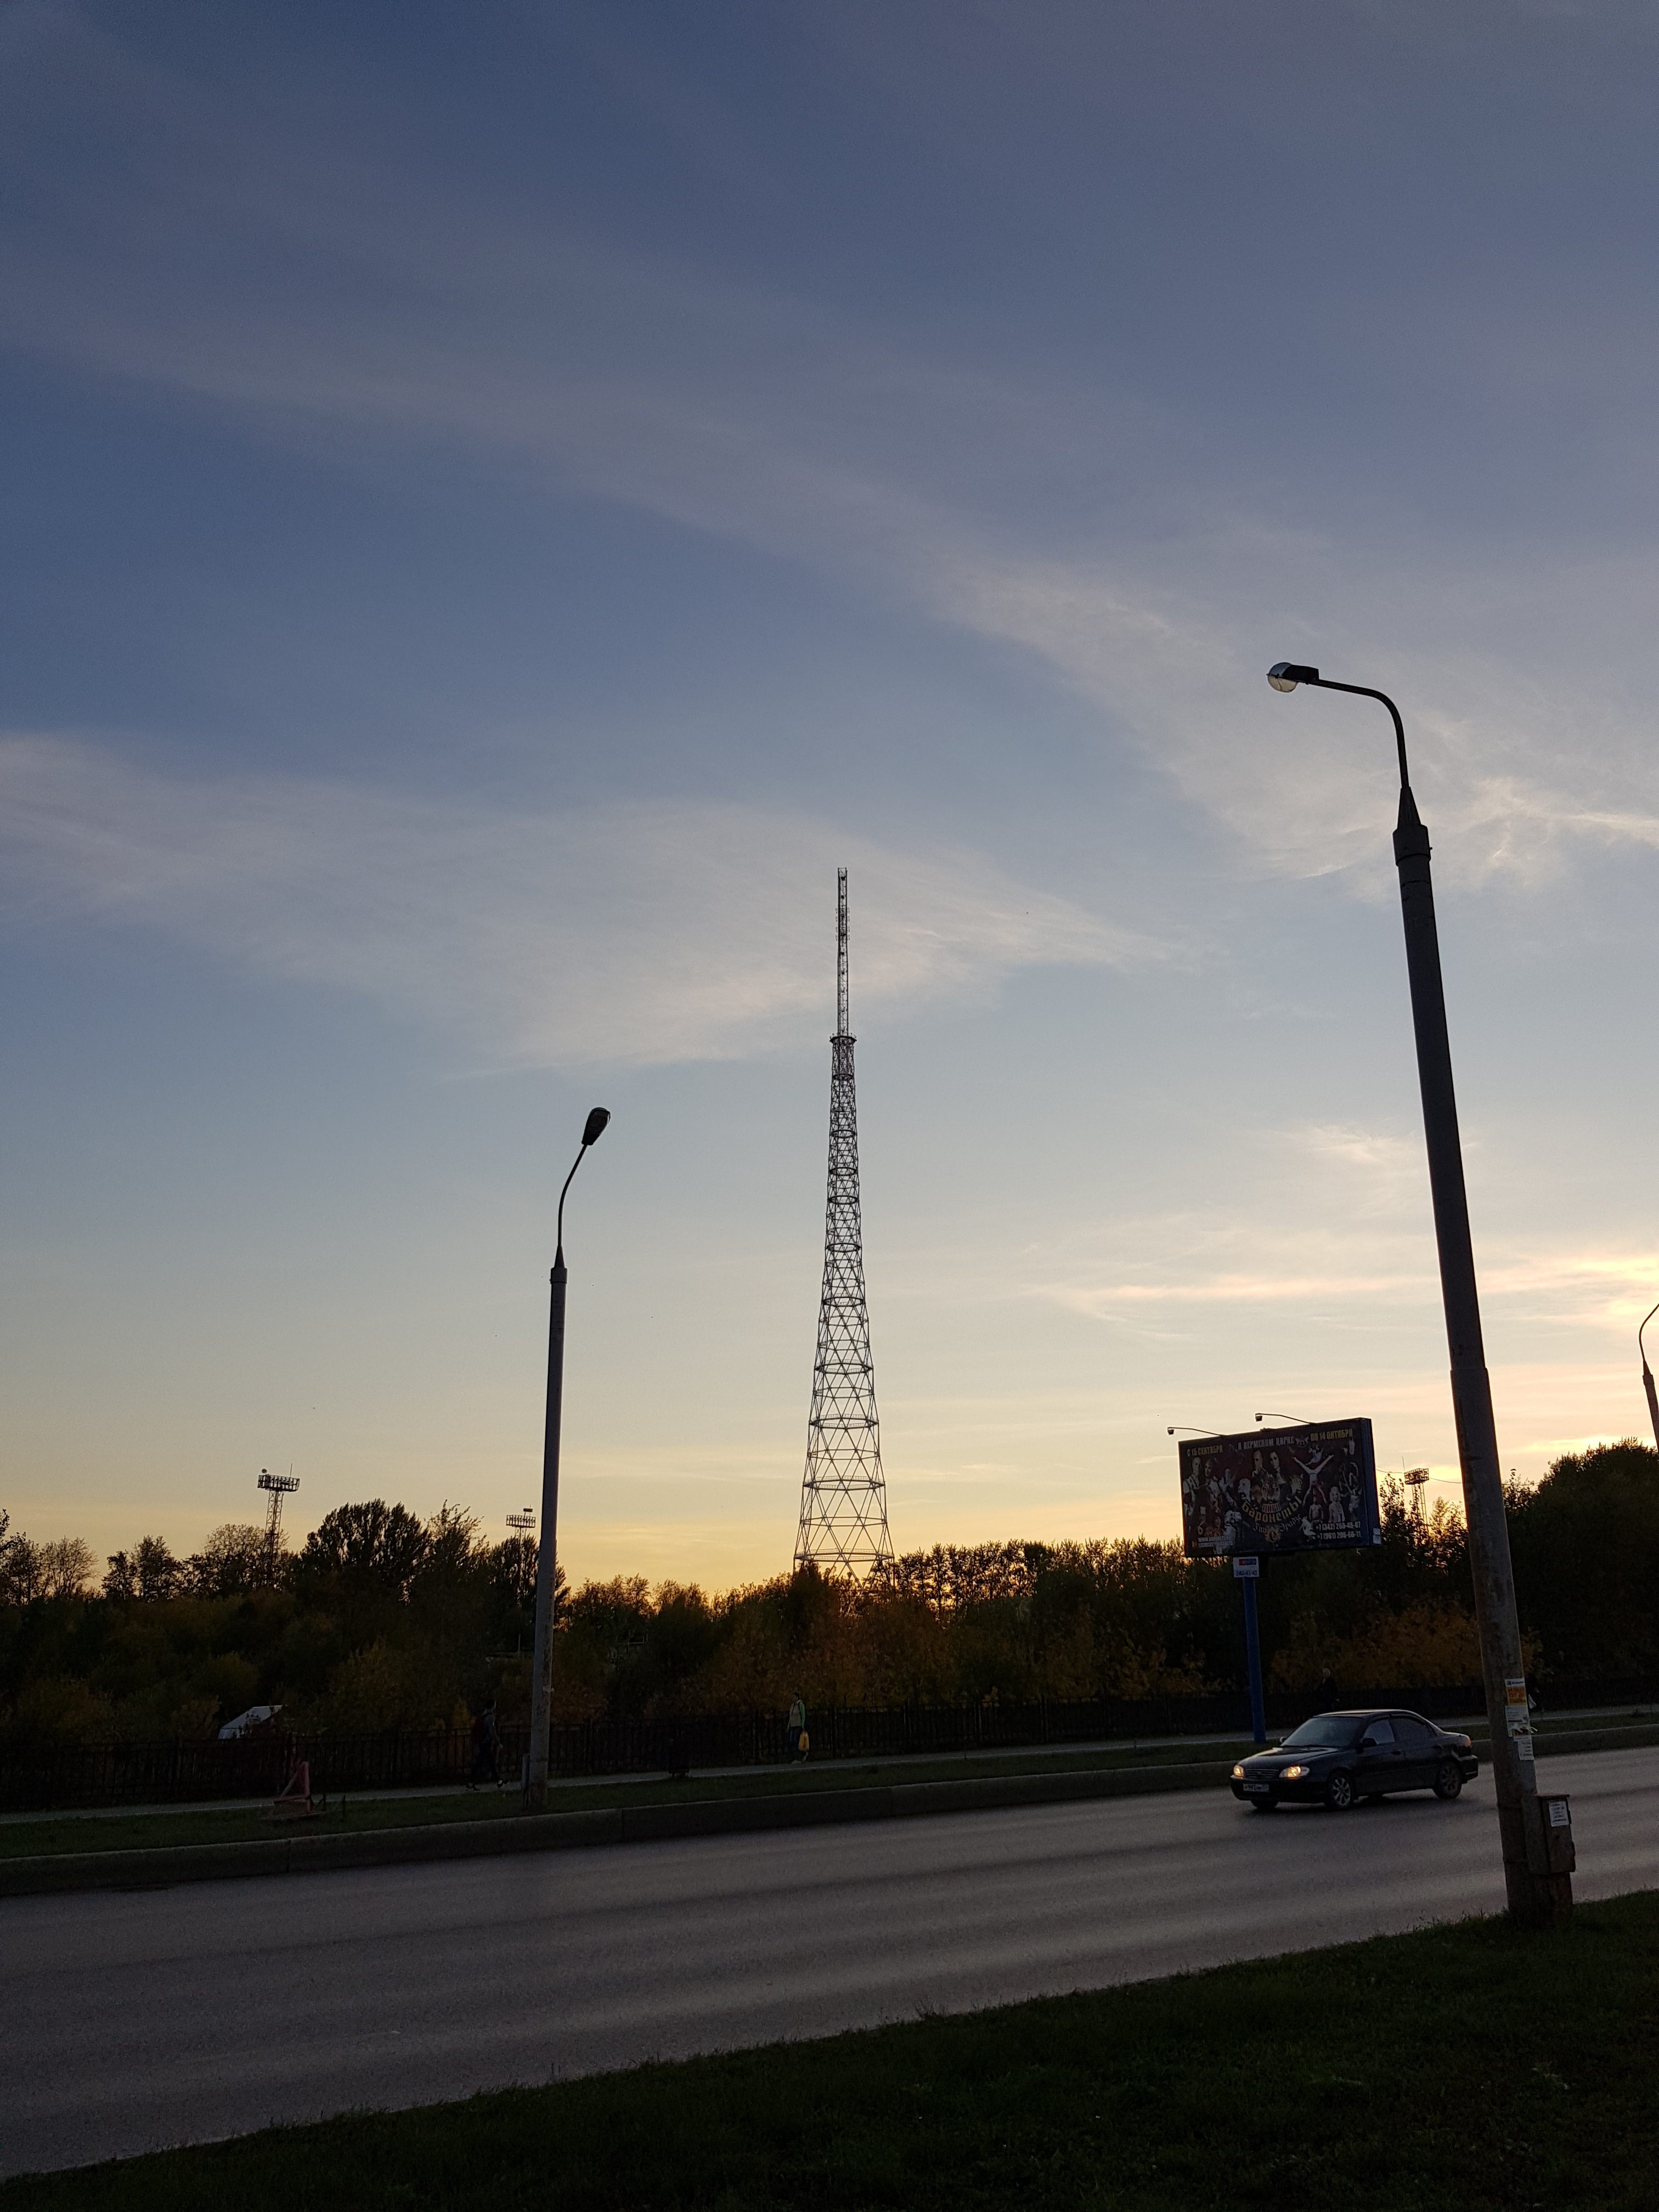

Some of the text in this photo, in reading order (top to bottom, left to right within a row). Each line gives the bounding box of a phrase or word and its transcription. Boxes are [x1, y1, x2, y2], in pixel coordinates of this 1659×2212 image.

[1310, 1429, 1353, 1441] ПО 14 ОКТЯБРЯ
[1198, 1444, 1223, 1455] СЕНТЯБРЯ
